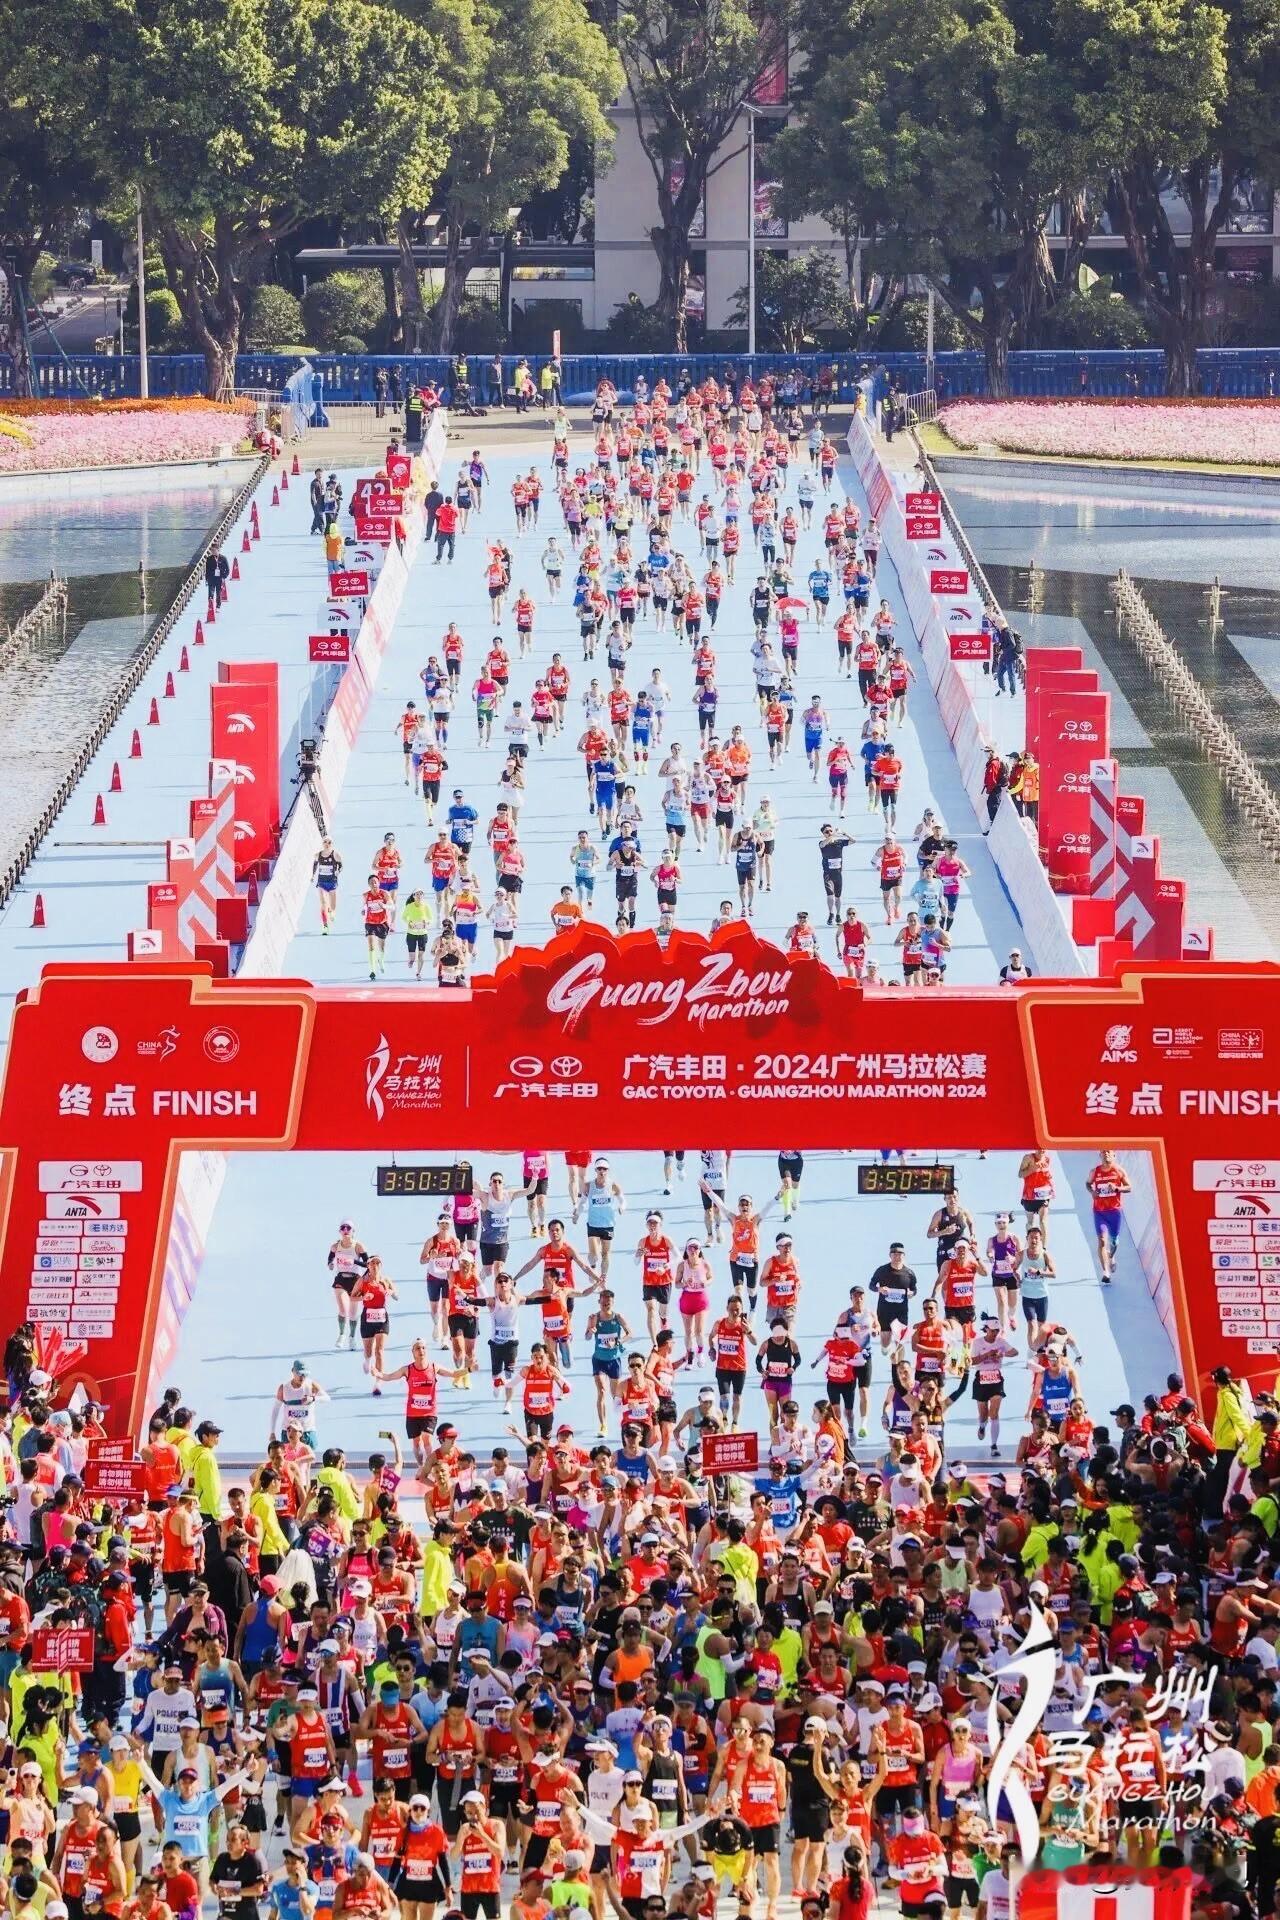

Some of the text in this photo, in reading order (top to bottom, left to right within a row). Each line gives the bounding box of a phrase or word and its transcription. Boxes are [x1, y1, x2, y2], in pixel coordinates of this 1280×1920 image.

[687, 999, 789, 1033] Marathon
[1101, 1050, 1138, 1063] AIMS
[394, 1055, 442, 1074] 广州
[384, 1075, 442, 1091] 马拉松
[494, 1082, 599, 1098] 广汽丰田
[622, 1085, 658, 1099] GAC
[660, 1085, 727, 1099] TOYOTA
[738, 1085, 845, 1099] GUANGZHOU
[848, 1085, 944, 1099] MARATHON
[948, 1085, 987, 1099] 2024
[153, 1090, 257, 1116] FINISH
[391, 1100, 442, 1109] Marathon
[1180, 1089, 1280, 1115] FINISH
[60, 1180, 121, 1189] 广汽丰田
[384, 1171, 467, 1192] 3:50:31
[865, 1170, 948, 1191] 3:50:31
[1215, 1179, 1276, 1188] 广汽丰田
[65, 1207, 87, 1216] ANTA
[1234, 1206, 1256, 1216] ANTA
[156, 1709, 180, 1718] POLIC
